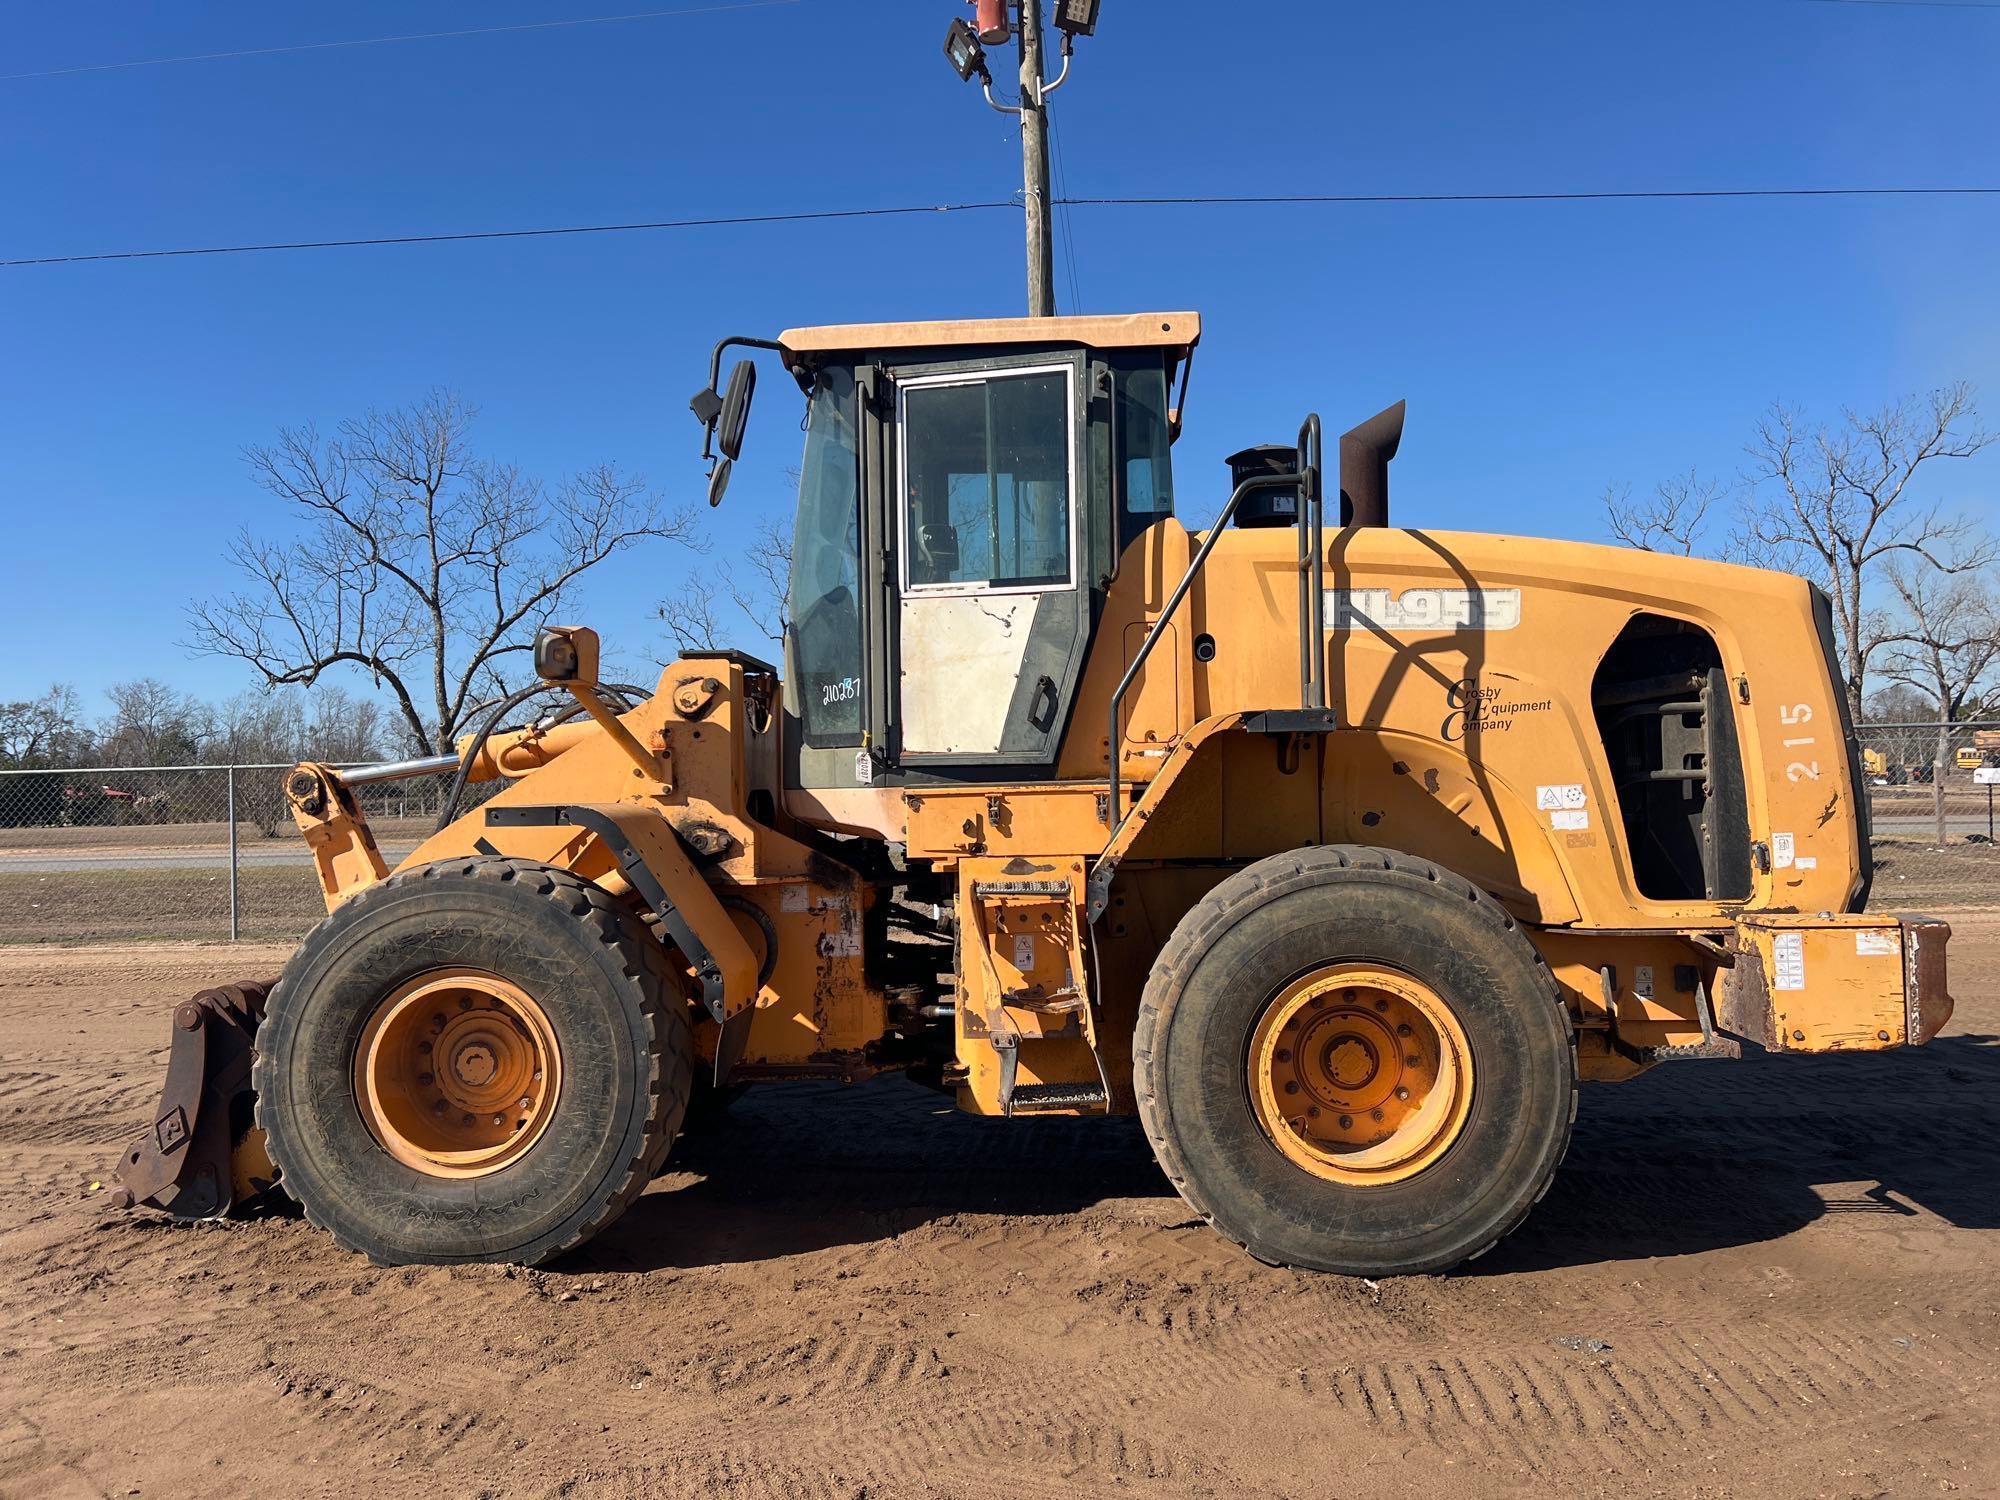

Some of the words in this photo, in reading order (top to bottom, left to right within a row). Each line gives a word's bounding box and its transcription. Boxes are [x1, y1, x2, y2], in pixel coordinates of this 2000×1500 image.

[1324, 588, 1520, 629] HL955
[822, 678, 860, 705] 210287
[1446, 678, 1501, 709] Crosby
[1471, 697, 1552, 722] Equipment
[1440, 710, 1512, 741] Company
[1779, 703, 1819, 783] 215
[407, 1187, 543, 1221] MAXAM
